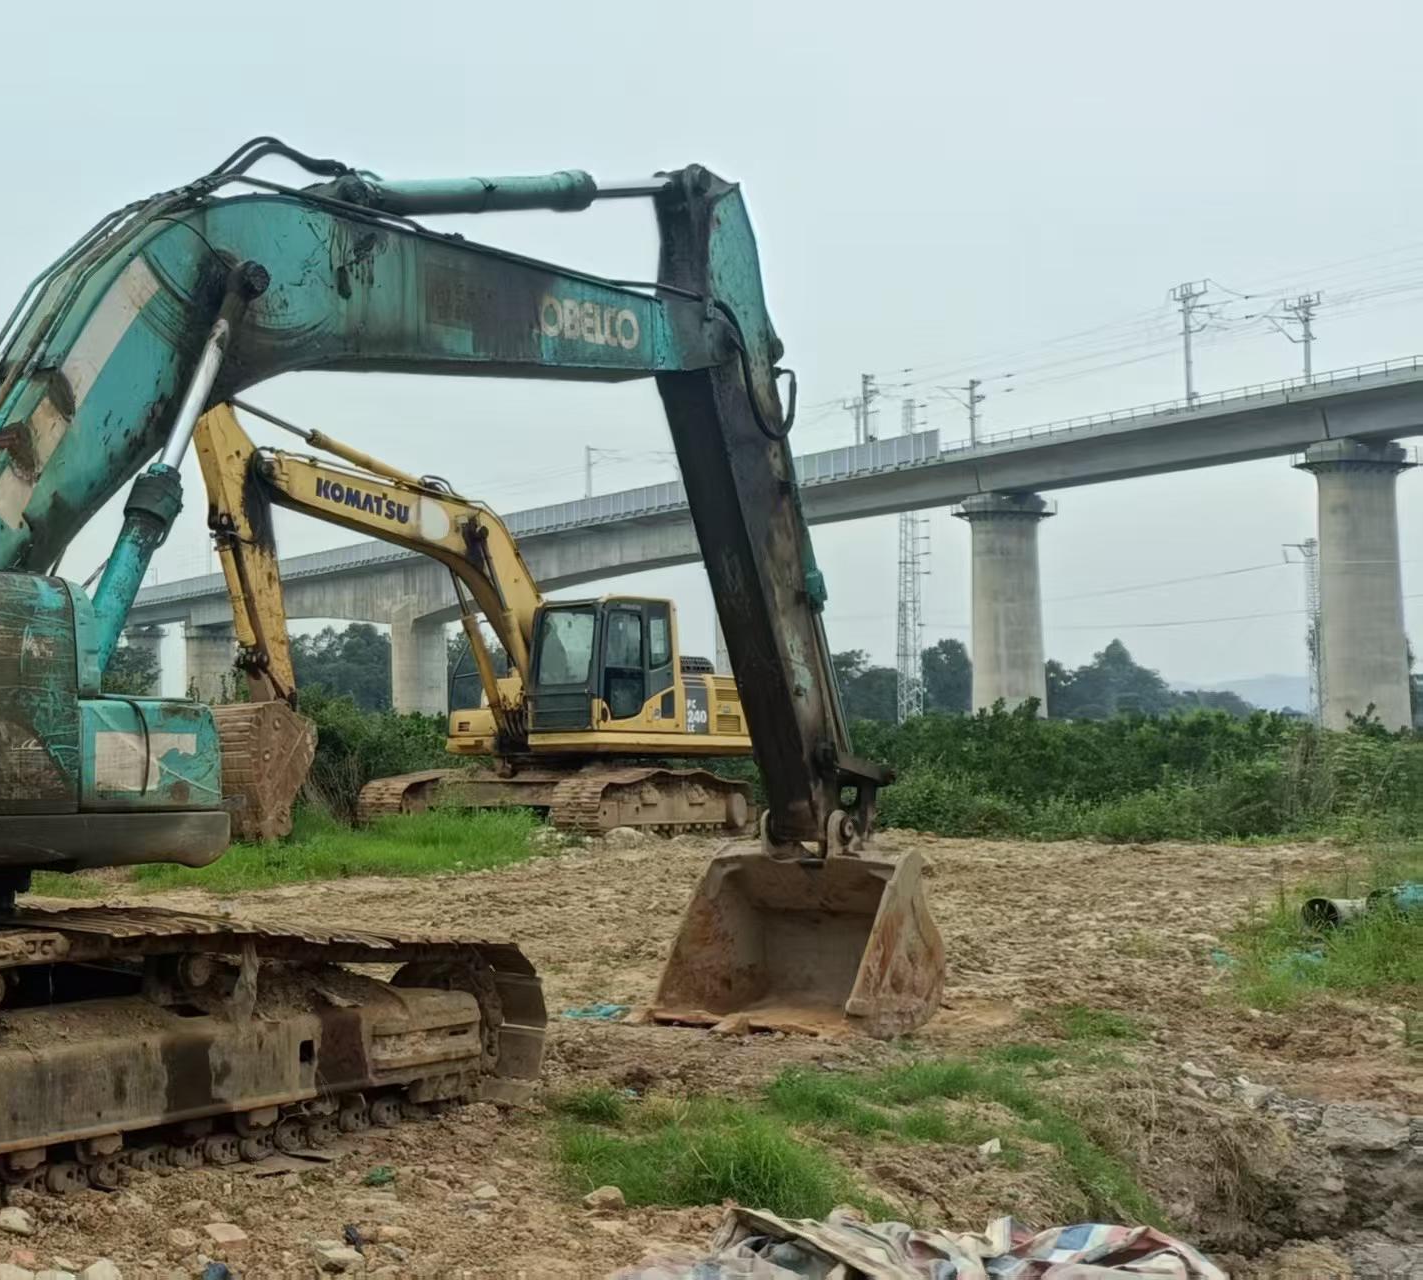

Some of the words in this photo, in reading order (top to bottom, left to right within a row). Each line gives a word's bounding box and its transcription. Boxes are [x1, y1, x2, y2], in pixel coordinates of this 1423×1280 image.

[535, 296, 640, 349] OBELCO
[316, 477, 410, 524] KOMATSU
[687, 710, 707, 723] 240
